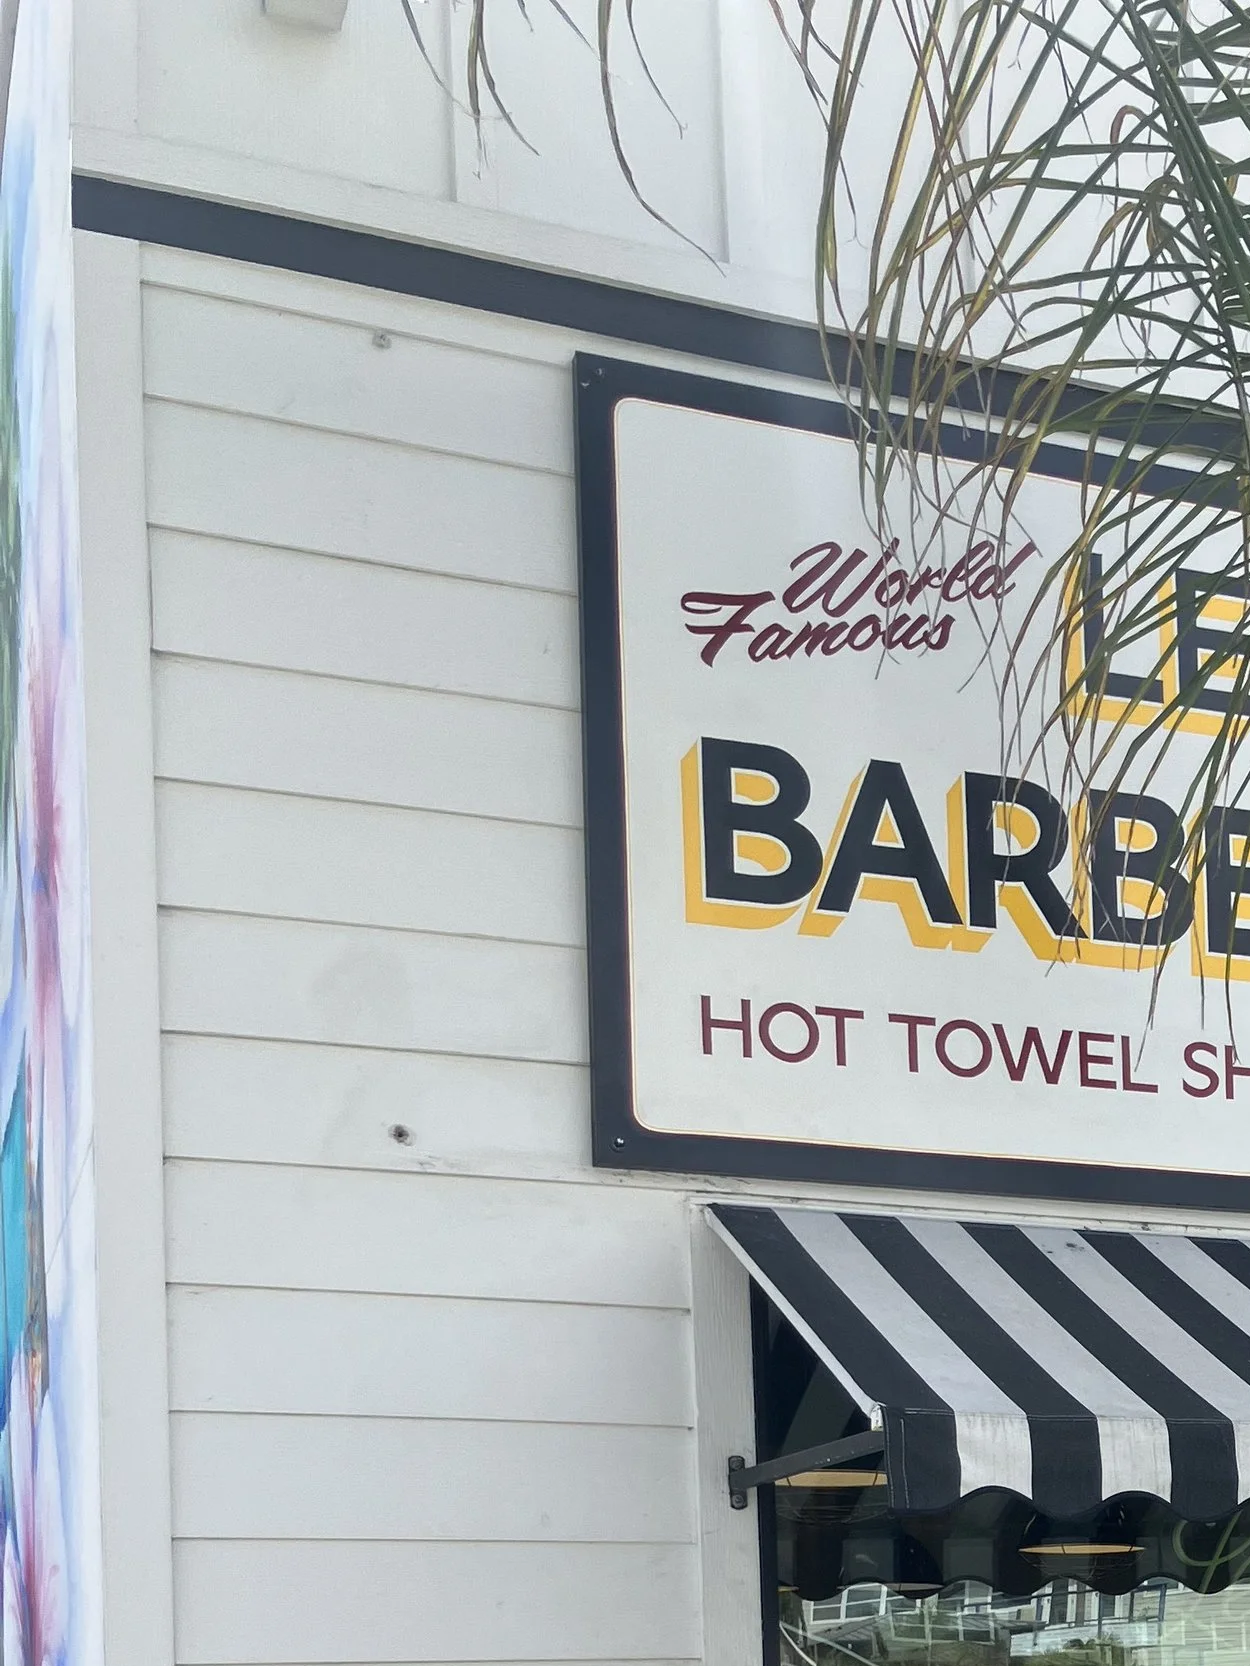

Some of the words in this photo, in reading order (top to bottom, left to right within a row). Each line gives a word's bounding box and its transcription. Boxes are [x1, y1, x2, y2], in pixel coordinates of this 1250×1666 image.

[784, 538, 1038, 618] World
[680, 588, 956, 668] Famous
[700, 994, 864, 1067] HOT
[888, 1012, 1159, 1094] TOWEL
